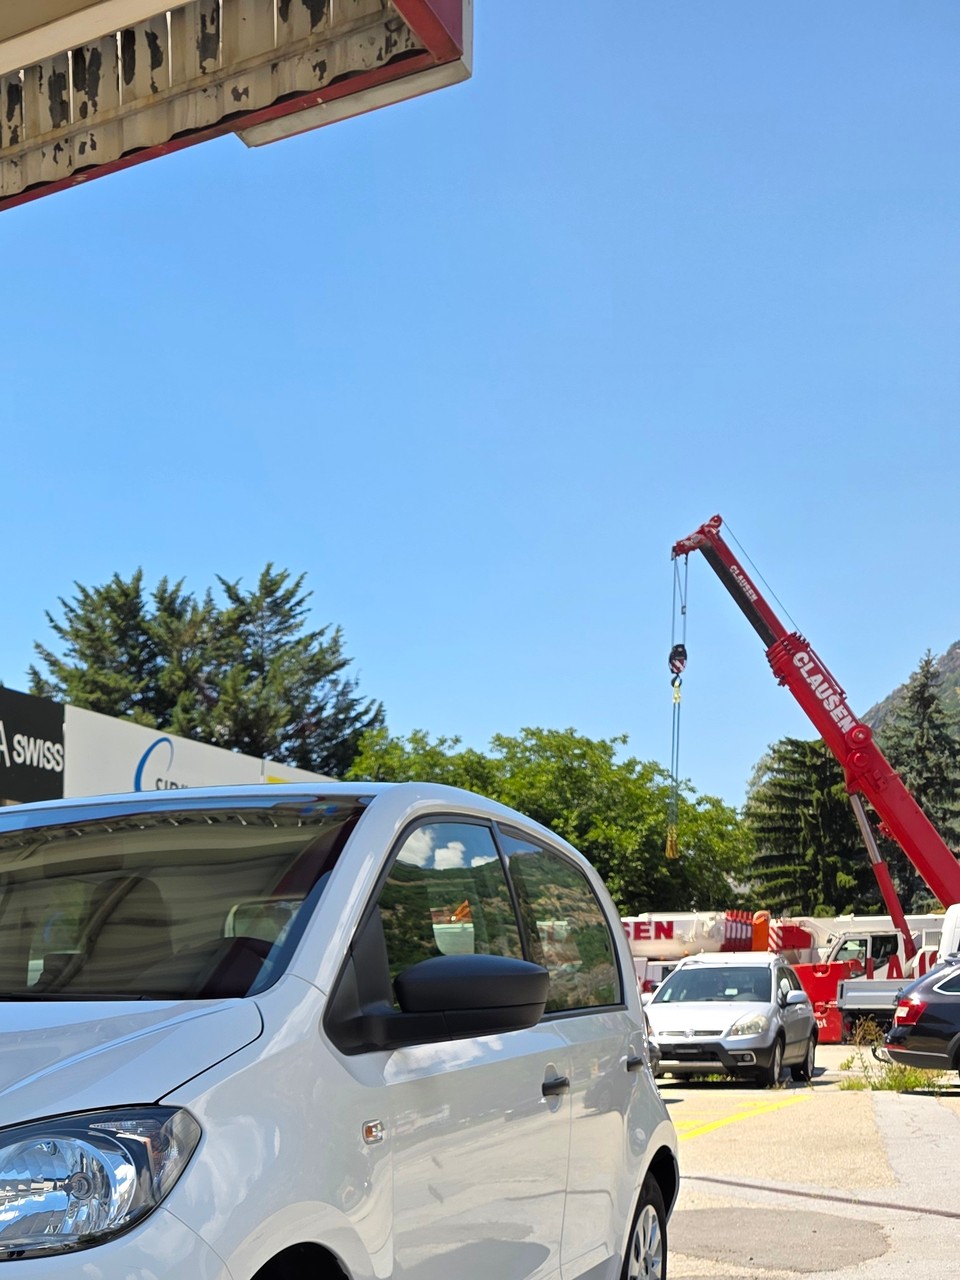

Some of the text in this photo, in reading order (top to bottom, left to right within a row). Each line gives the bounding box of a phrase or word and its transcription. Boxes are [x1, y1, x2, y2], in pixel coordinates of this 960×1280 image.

[729, 564, 758, 602] CLAUSEN
[792, 652, 856, 733] CLAUSEN
[12, 733, 64, 773] SWISS
